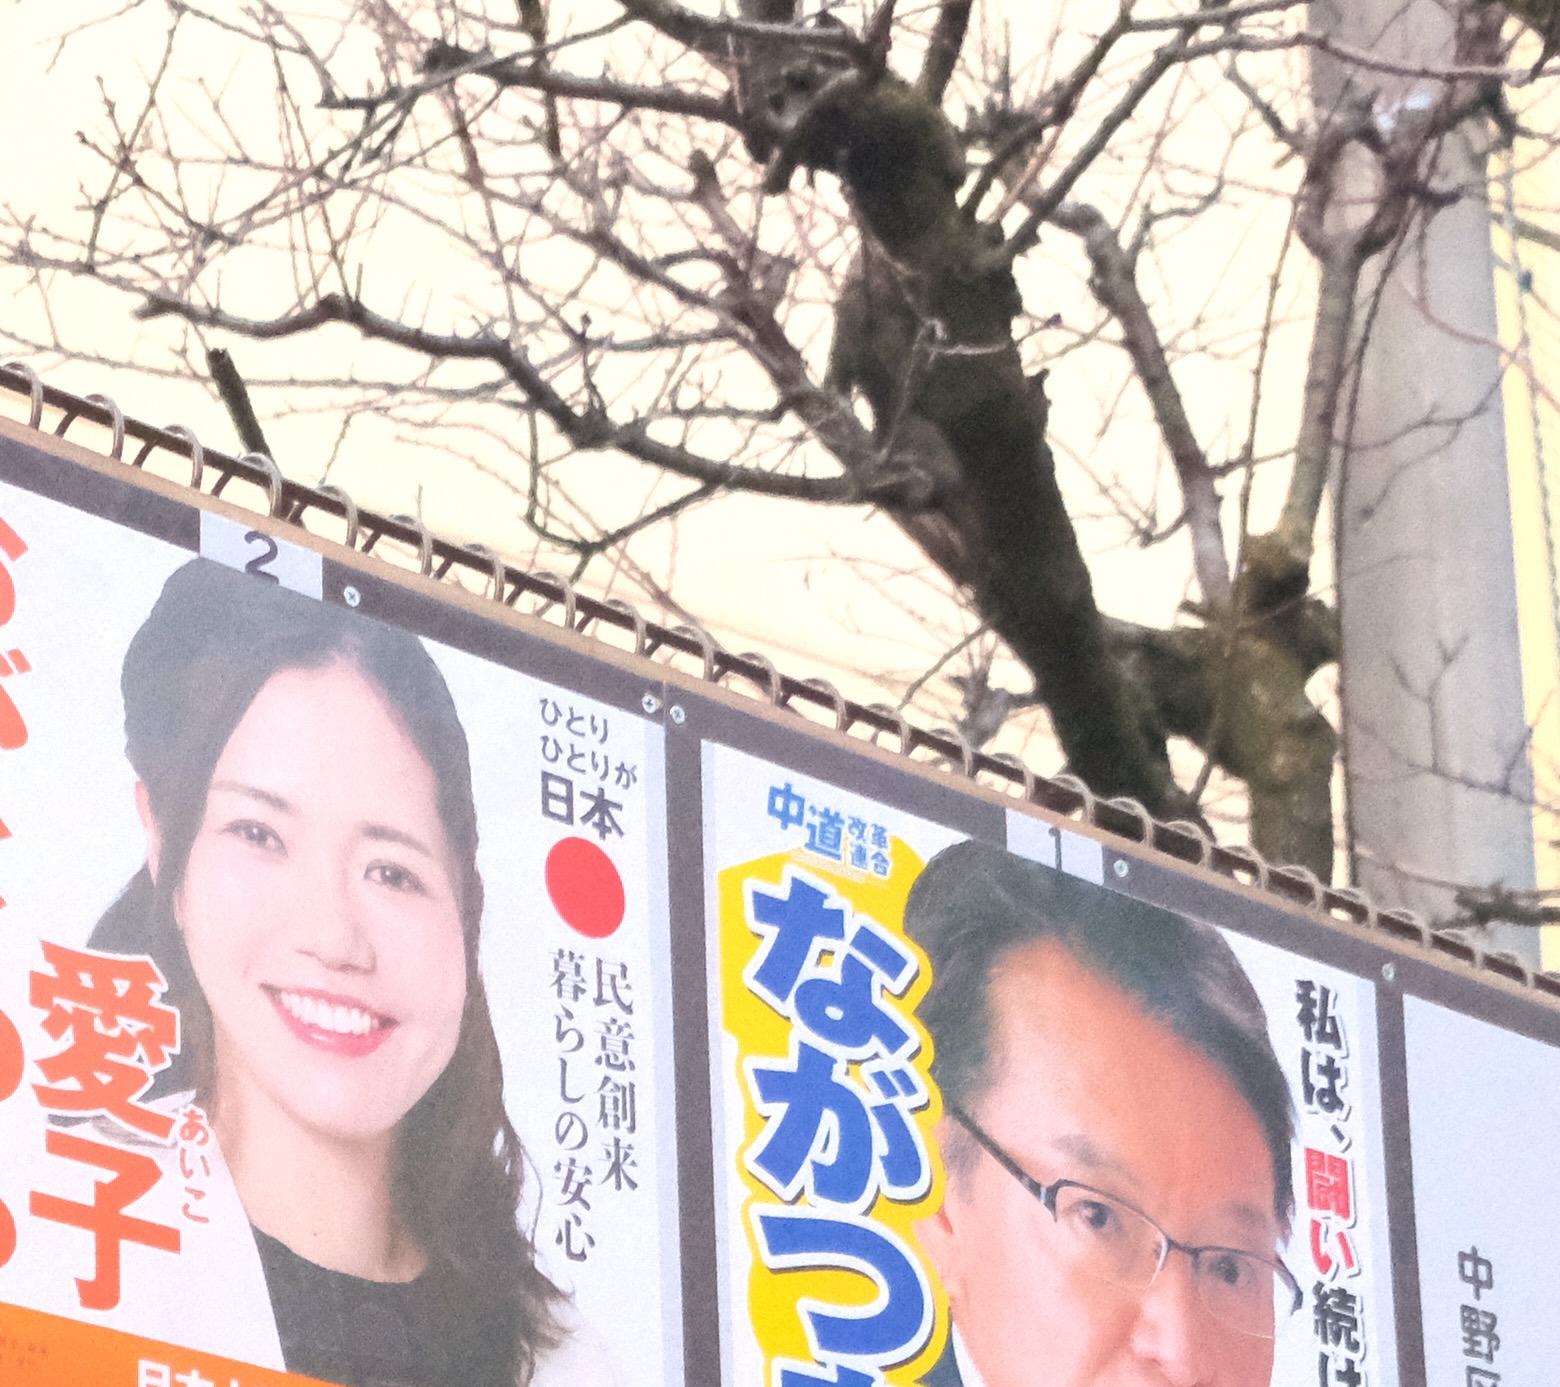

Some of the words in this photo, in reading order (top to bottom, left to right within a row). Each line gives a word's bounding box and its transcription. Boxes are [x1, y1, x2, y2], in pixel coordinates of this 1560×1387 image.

[244, 530, 280, 585] 2
[538, 697, 609, 742] ひとり
[539, 734, 638, 787] ひとりが
[539, 771, 625, 842] 日本
[767, 782, 845, 861] 中道
[547, 950, 596, 1264] 暮らしの安心
[591, 957, 640, 1192] 民意創来
[29, 939, 181, 1311] 愛子
[176, 1107, 212, 1226] あいこ
